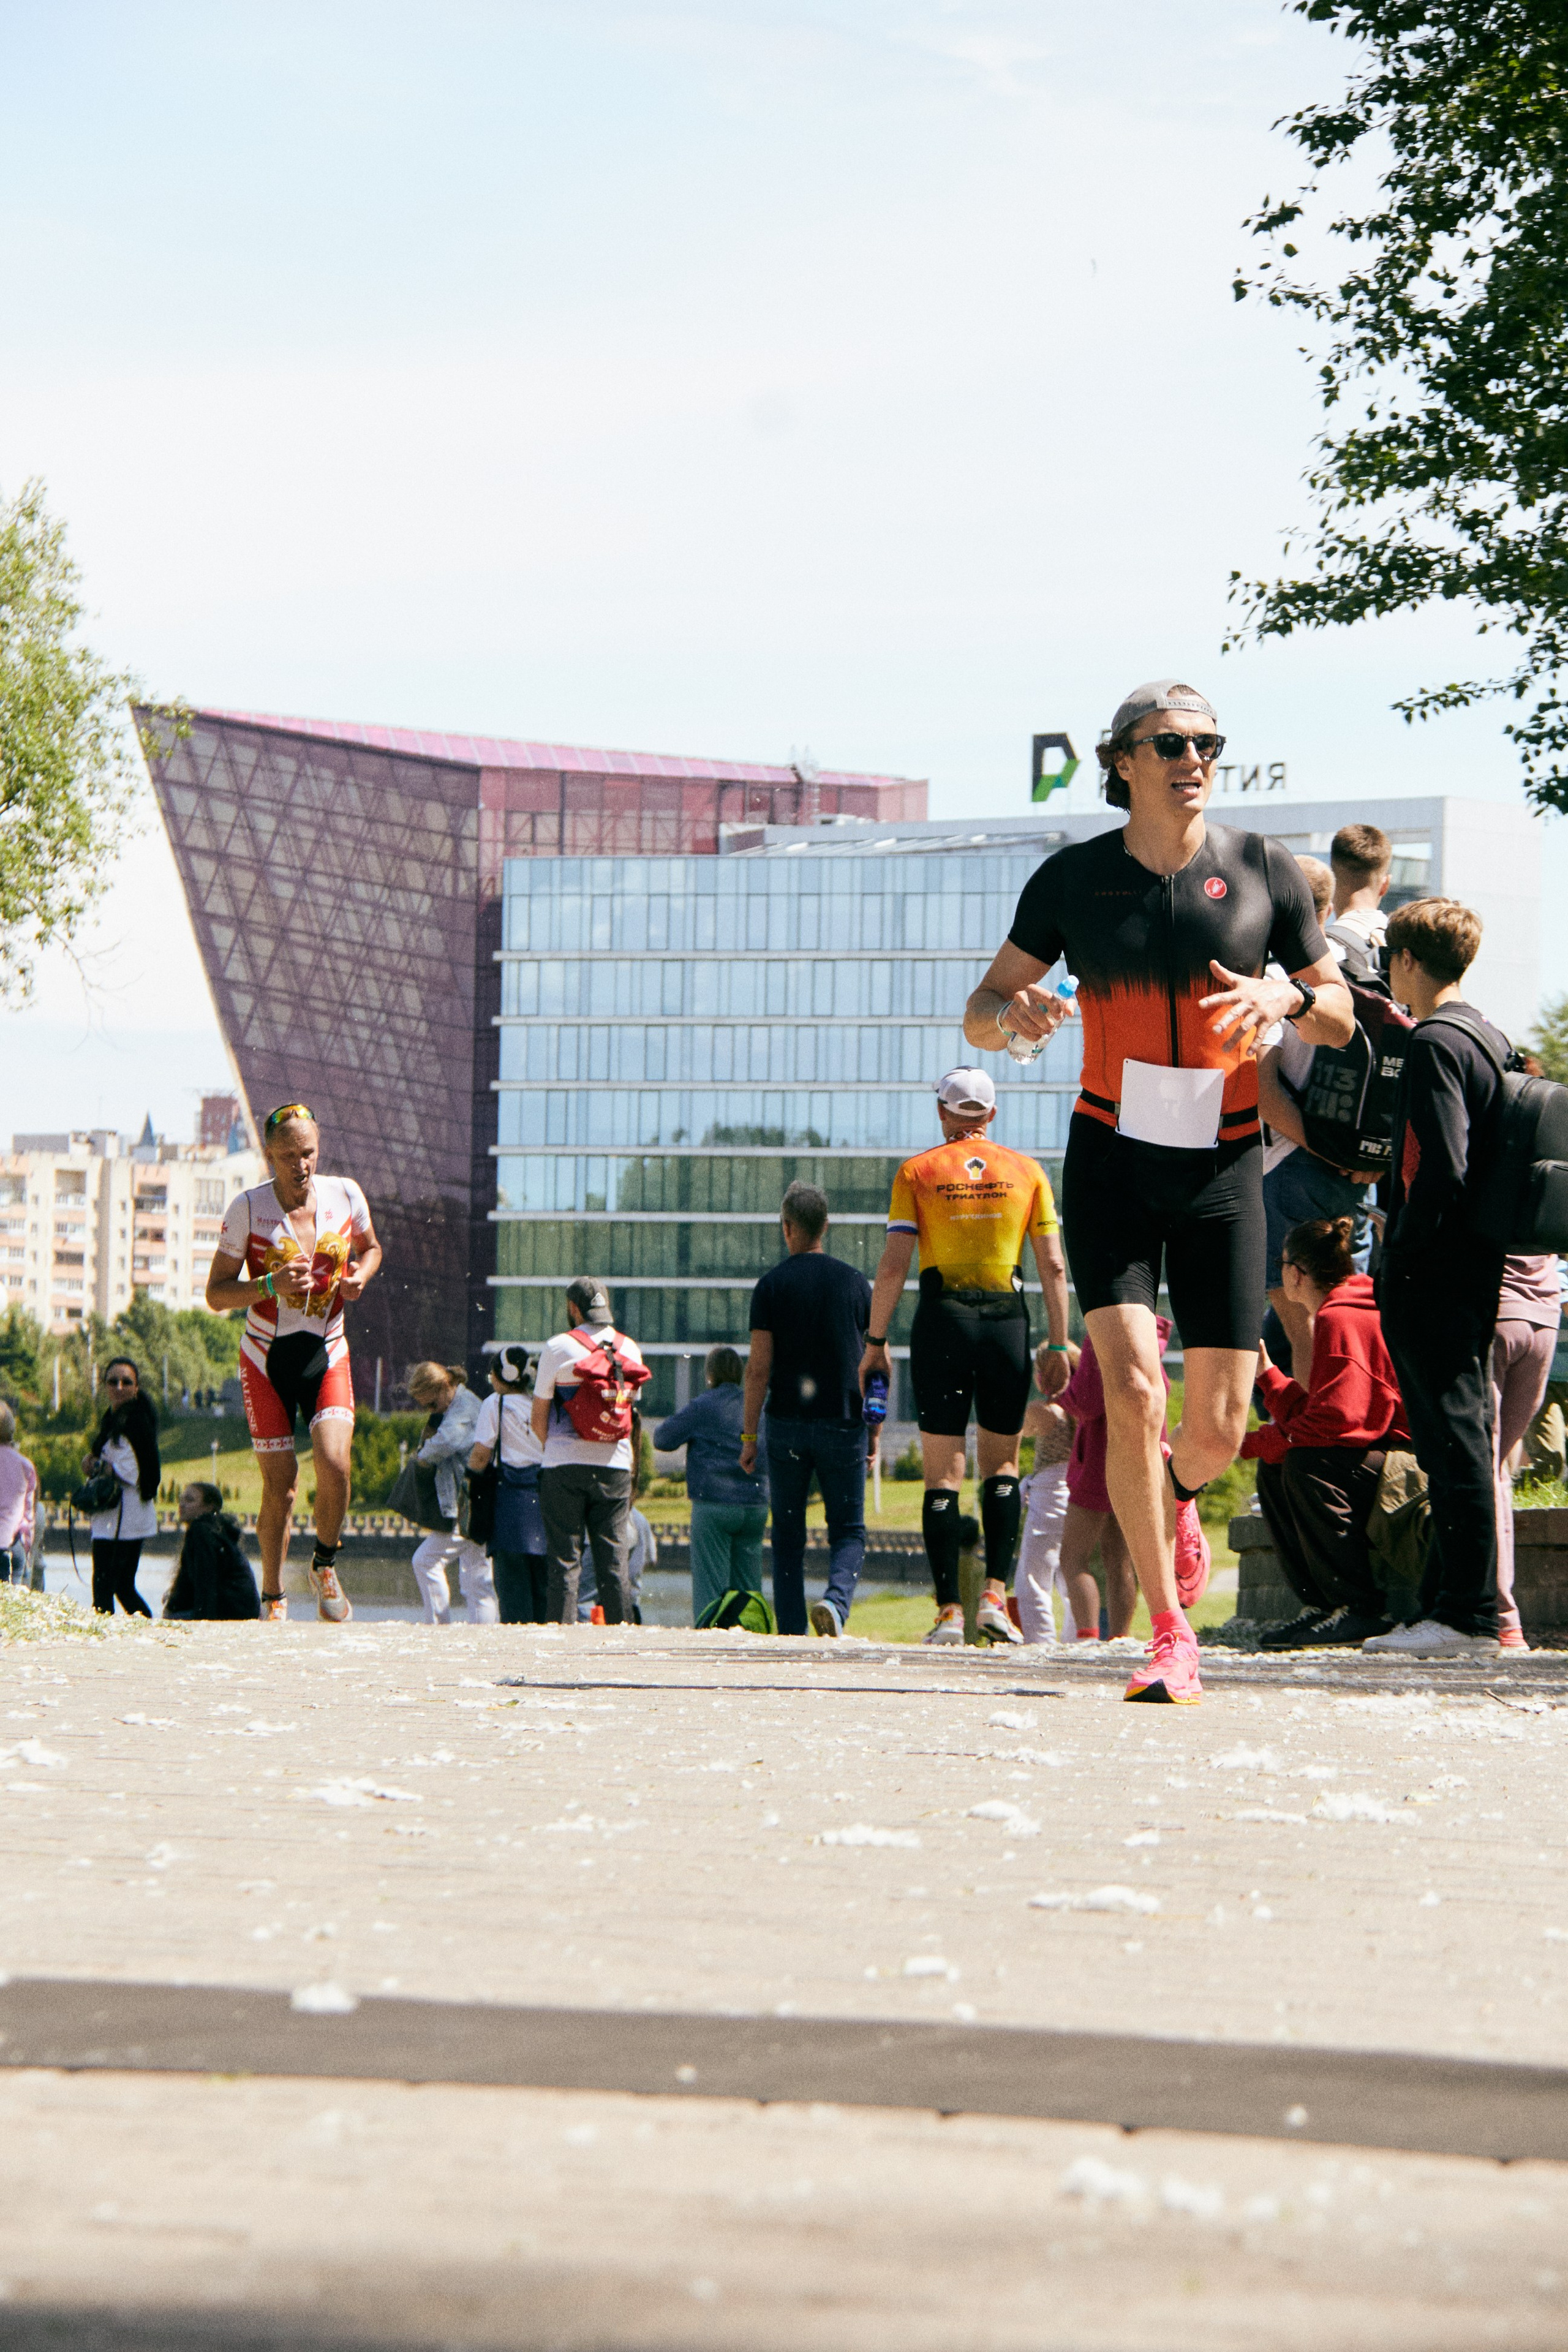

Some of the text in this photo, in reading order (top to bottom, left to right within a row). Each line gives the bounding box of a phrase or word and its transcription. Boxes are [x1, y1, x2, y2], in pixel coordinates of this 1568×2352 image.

[1314, 1061, 1358, 1091] 113
[937, 1182, 1014, 1193] РОСНЕФТЬ
[945, 1192, 1007, 1200] ТРИАТЛОН
